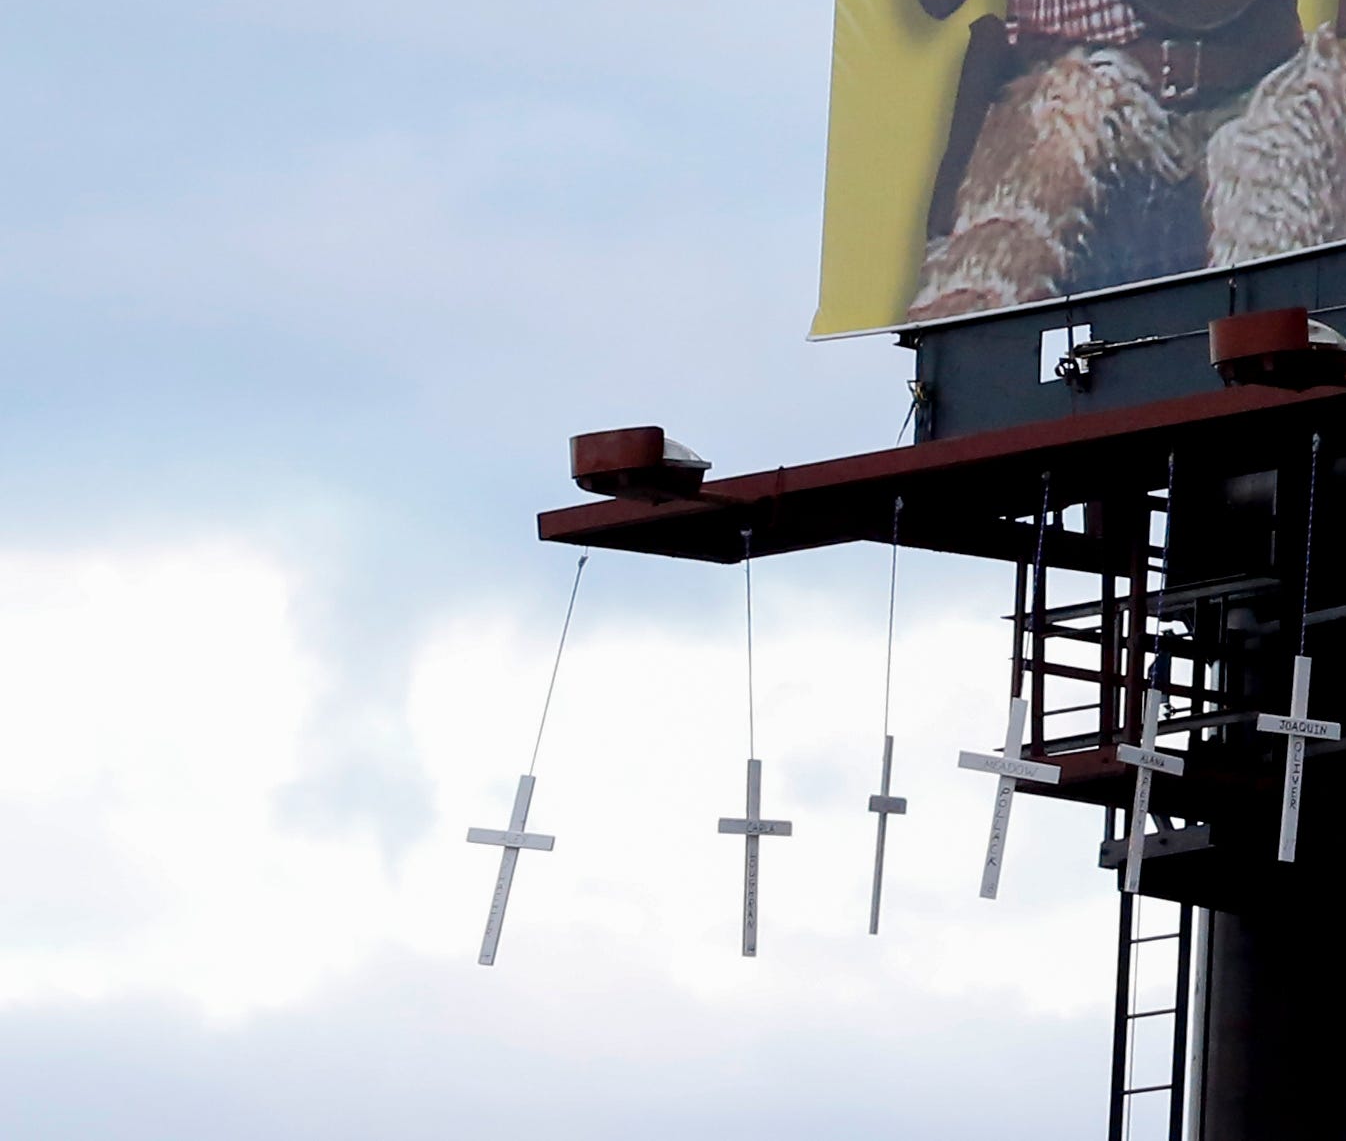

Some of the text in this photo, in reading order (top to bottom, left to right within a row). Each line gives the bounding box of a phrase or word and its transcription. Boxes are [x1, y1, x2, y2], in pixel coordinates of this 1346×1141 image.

[1279, 718, 1329, 737] JOAQUIN
[983, 760, 1040, 779] MEADOW
[1289, 741, 1303, 810] OLIVER
[986, 786, 1012, 868] POLLACK
